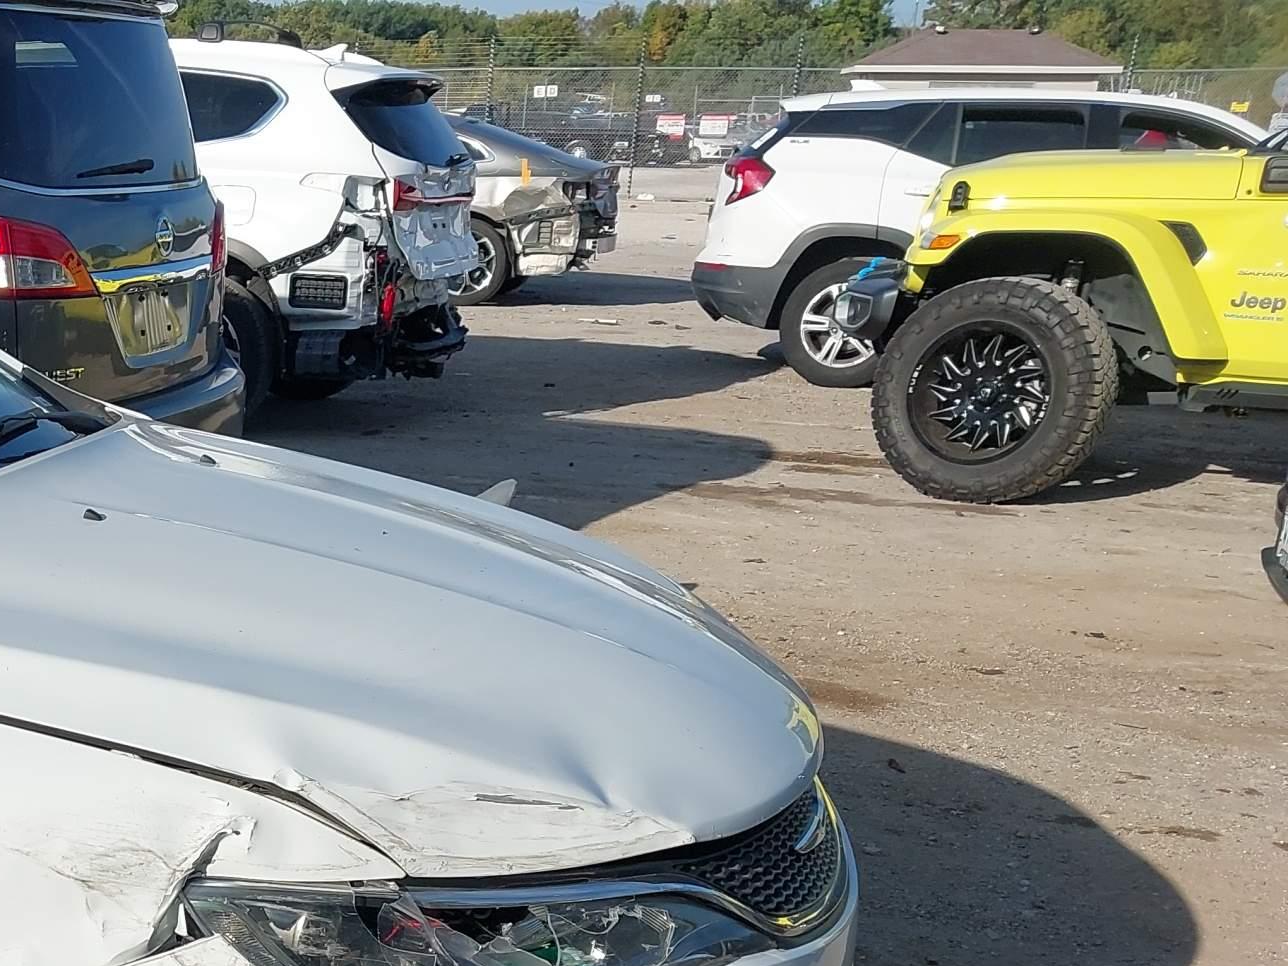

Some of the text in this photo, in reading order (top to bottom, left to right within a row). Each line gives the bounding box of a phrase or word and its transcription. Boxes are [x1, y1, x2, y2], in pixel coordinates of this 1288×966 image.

[1230, 291, 1287, 313] Jeep
[45, 367, 85, 382] UEST
[908, 364, 923, 394] FUEL
